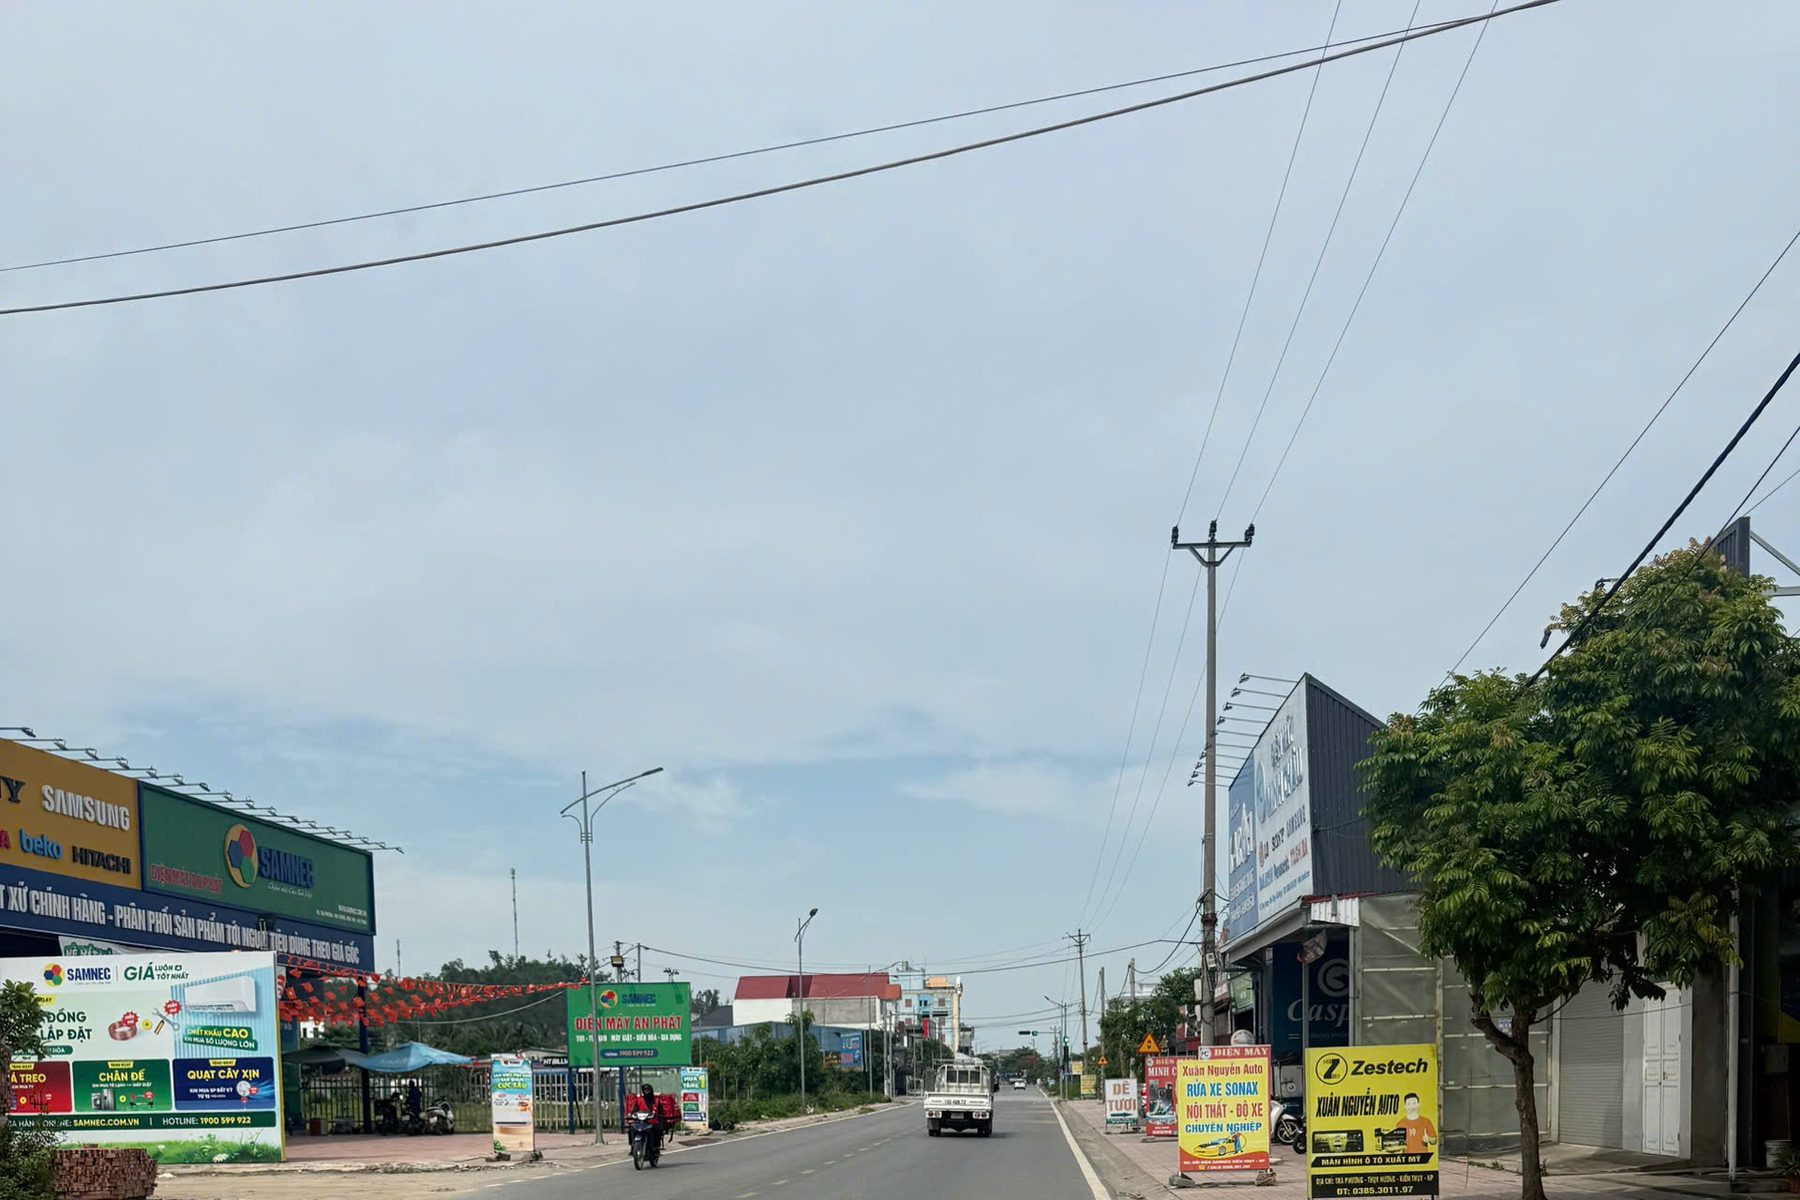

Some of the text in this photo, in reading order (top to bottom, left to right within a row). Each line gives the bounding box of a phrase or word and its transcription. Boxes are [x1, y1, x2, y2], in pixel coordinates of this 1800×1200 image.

[41, 784, 131, 831] SAMSUNG
[18, 828, 63, 860] beko
[71, 845, 131, 874] HITACHI
[258, 847, 315, 889] SAMNEC
[8, 881, 28, 912] XỨ
[30, 887, 70, 919] CHÍNH
[114, 902, 147, 931] PHÂN
[147, 906, 173, 936] PHỐI
[174, 909, 196, 939] SẢN
[225, 919, 241, 946] TỚI
[288, 930, 310, 957] DÙNG
[311, 938, 331, 960] THEO
[331, 939, 345, 962] GIÁ
[345, 939, 360, 964] GỐC
[67, 961, 155, 982] SAMNEC GIÁ
[155, 964, 174, 972] LUÔN
[156, 971, 189, 980] TỐT NHẤT
[1287, 998, 1349, 1028] Casp
[605, 1012, 630, 1030] MÁY
[634, 1016, 650, 1030] AN
[653, 1012, 682, 1030] PHÁT
[40, 1024, 92, 1043] LẮP ĐẶT
[223, 1028, 249, 1039] CAO
[215, 1039, 238, 1047] LƯỢNG
[239, 1040, 255, 1048] LỚN
[1148, 1066, 1170, 1077] MINH
[1182, 1063, 1205, 1077] Xuân
[1243, 1063, 1264, 1074] Auto
[1350, 1057, 1429, 1076] Zestech
[19, 1073, 47, 1083] TREO
[99, 1068, 146, 1082] CHÂN ĐẾ
[187, 1067, 260, 1082] QUẠT CÂY XỊN
[1112, 1081, 1131, 1095] DÊ
[1186, 1078, 1259, 1097] RỬA XE SONAX
[1107, 1098, 1137, 1111] TƯƠI
[1186, 1103, 1203, 1122] NỘI
[1205, 1098, 1228, 1118] THẤT
[1236, 1100, 1250, 1121] ĐỘ
[1251, 1103, 1264, 1117] XE
[1315, 1091, 1341, 1118] XUÂN
[1377, 1093, 1400, 1116] AUTO
[18, 1118, 36, 1127] HÀN
[73, 1119, 139, 1127] SAMNEC.COM.VN
[162, 1117, 199, 1125] HOTLINE:
[200, 1117, 219, 1125] 1900
[237, 1116, 251, 1124] 922
[1185, 1121, 1262, 1134] CHUYÊN NGHIỆP
[1321, 1157, 1341, 1166] MÀN
[1342, 1156, 1363, 1165] HÌNH
[1364, 1155, 1371, 1165] Ô
[1373, 1155, 1383, 1164] TÔ
[1385, 1154, 1406, 1163] XUẤT
[1337, 1185, 1414, 1195] ĐT: 0385.3011.97
